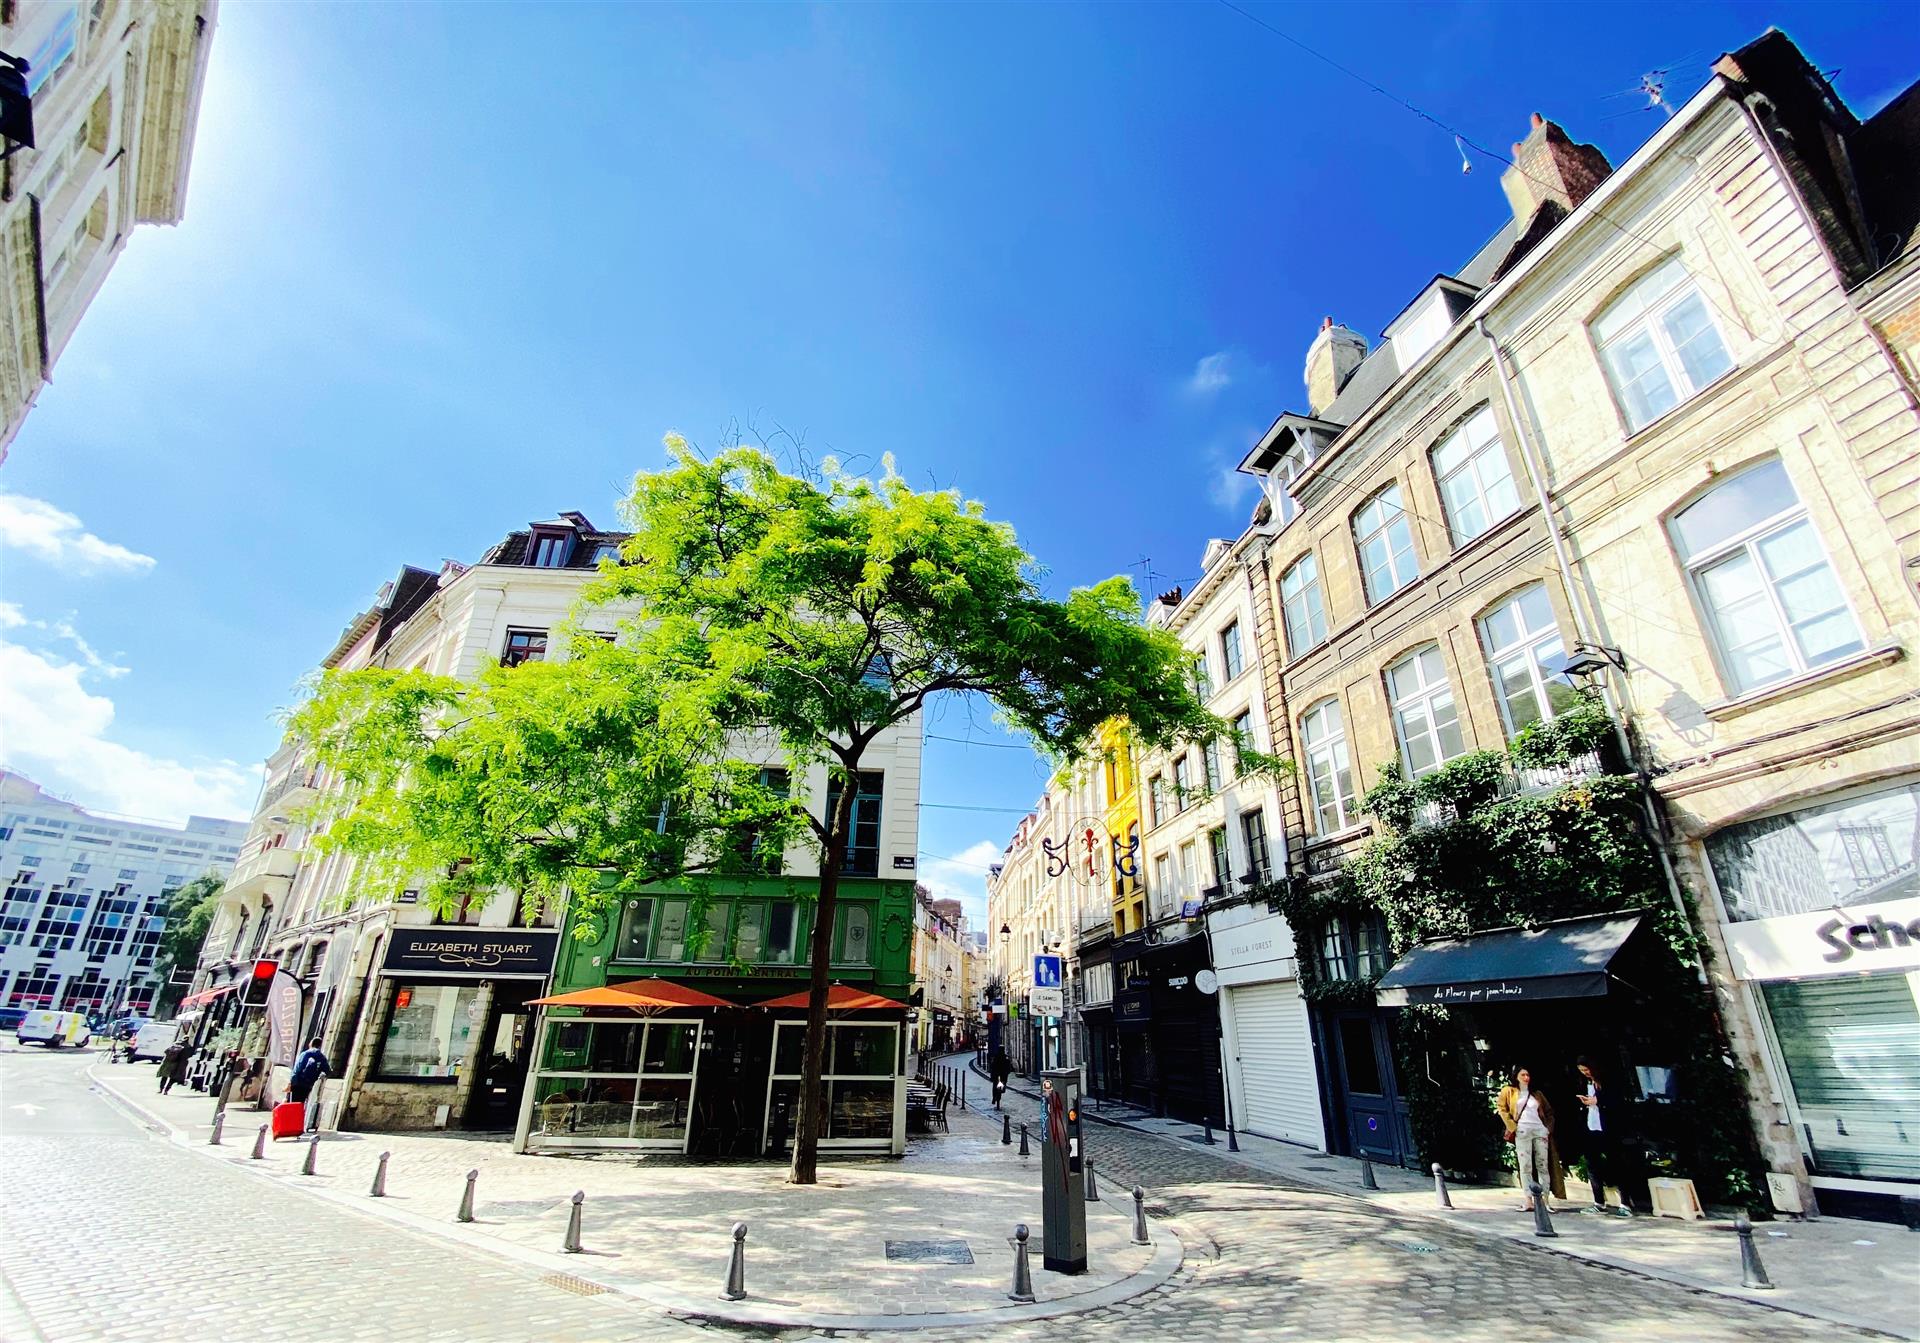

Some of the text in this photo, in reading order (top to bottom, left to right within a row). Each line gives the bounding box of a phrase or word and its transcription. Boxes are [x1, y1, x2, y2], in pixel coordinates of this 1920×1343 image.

[410, 942, 532, 954] ELIZABETH STUART
[1230, 940, 1272, 956] STELLA FOREST
